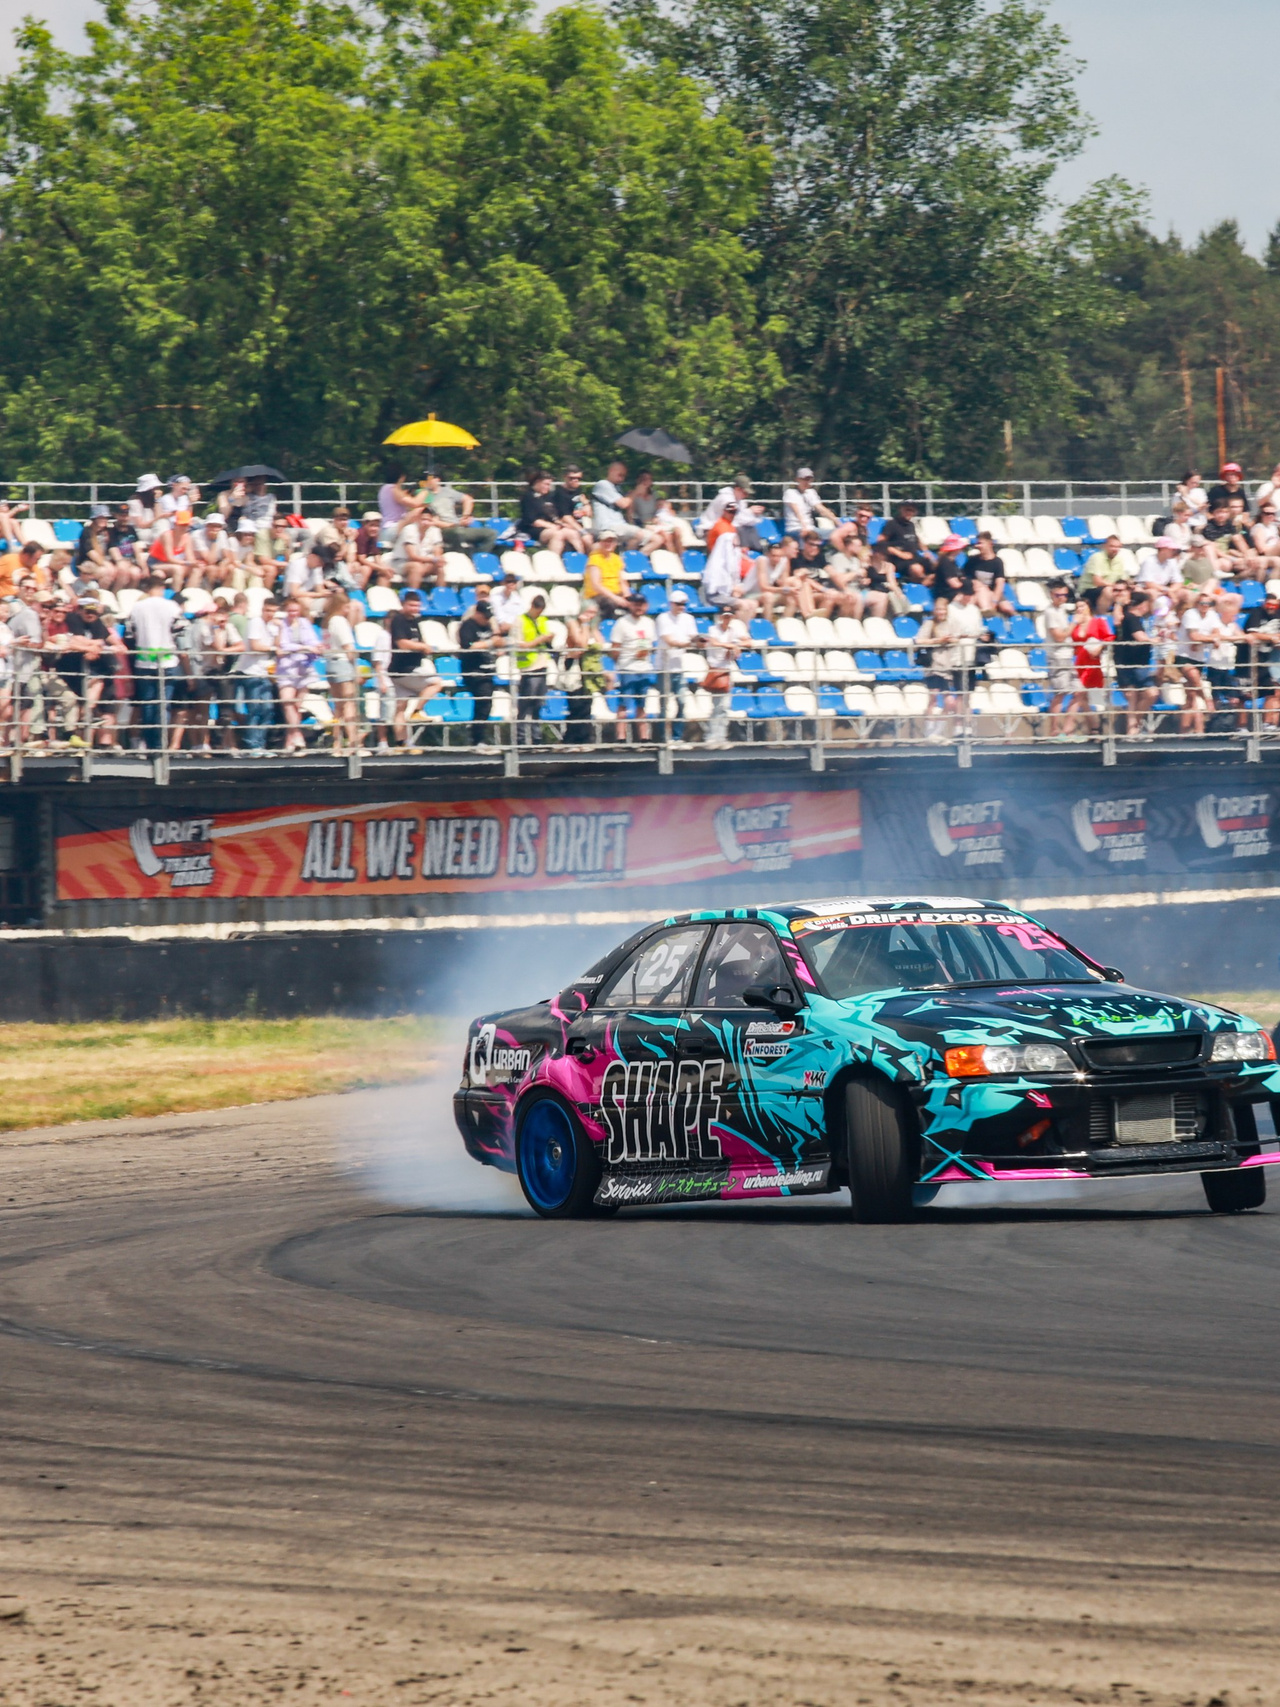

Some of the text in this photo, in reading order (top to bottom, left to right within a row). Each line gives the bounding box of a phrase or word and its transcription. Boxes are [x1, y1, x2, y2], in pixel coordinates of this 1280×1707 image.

[949, 800, 1004, 826] DRIFT
[1092, 798, 1147, 823] DRIFT
[152, 818, 215, 845] DRIFT
[301, 812, 631, 880] ALL WE NEED IS DRIFT
[849, 913, 1029, 925] DRIFT EXPO CUP
[997, 924, 1067, 951] 25
[639, 944, 688, 987] 25
[493, 1049, 531, 1071] URBAN
[745, 1040, 788, 1055] KINFOREST
[600, 1058, 725, 1164] SHAPE
[600, 1177, 653, 1200] Service
[742, 1169, 824, 1190] urbandetailing.ru
